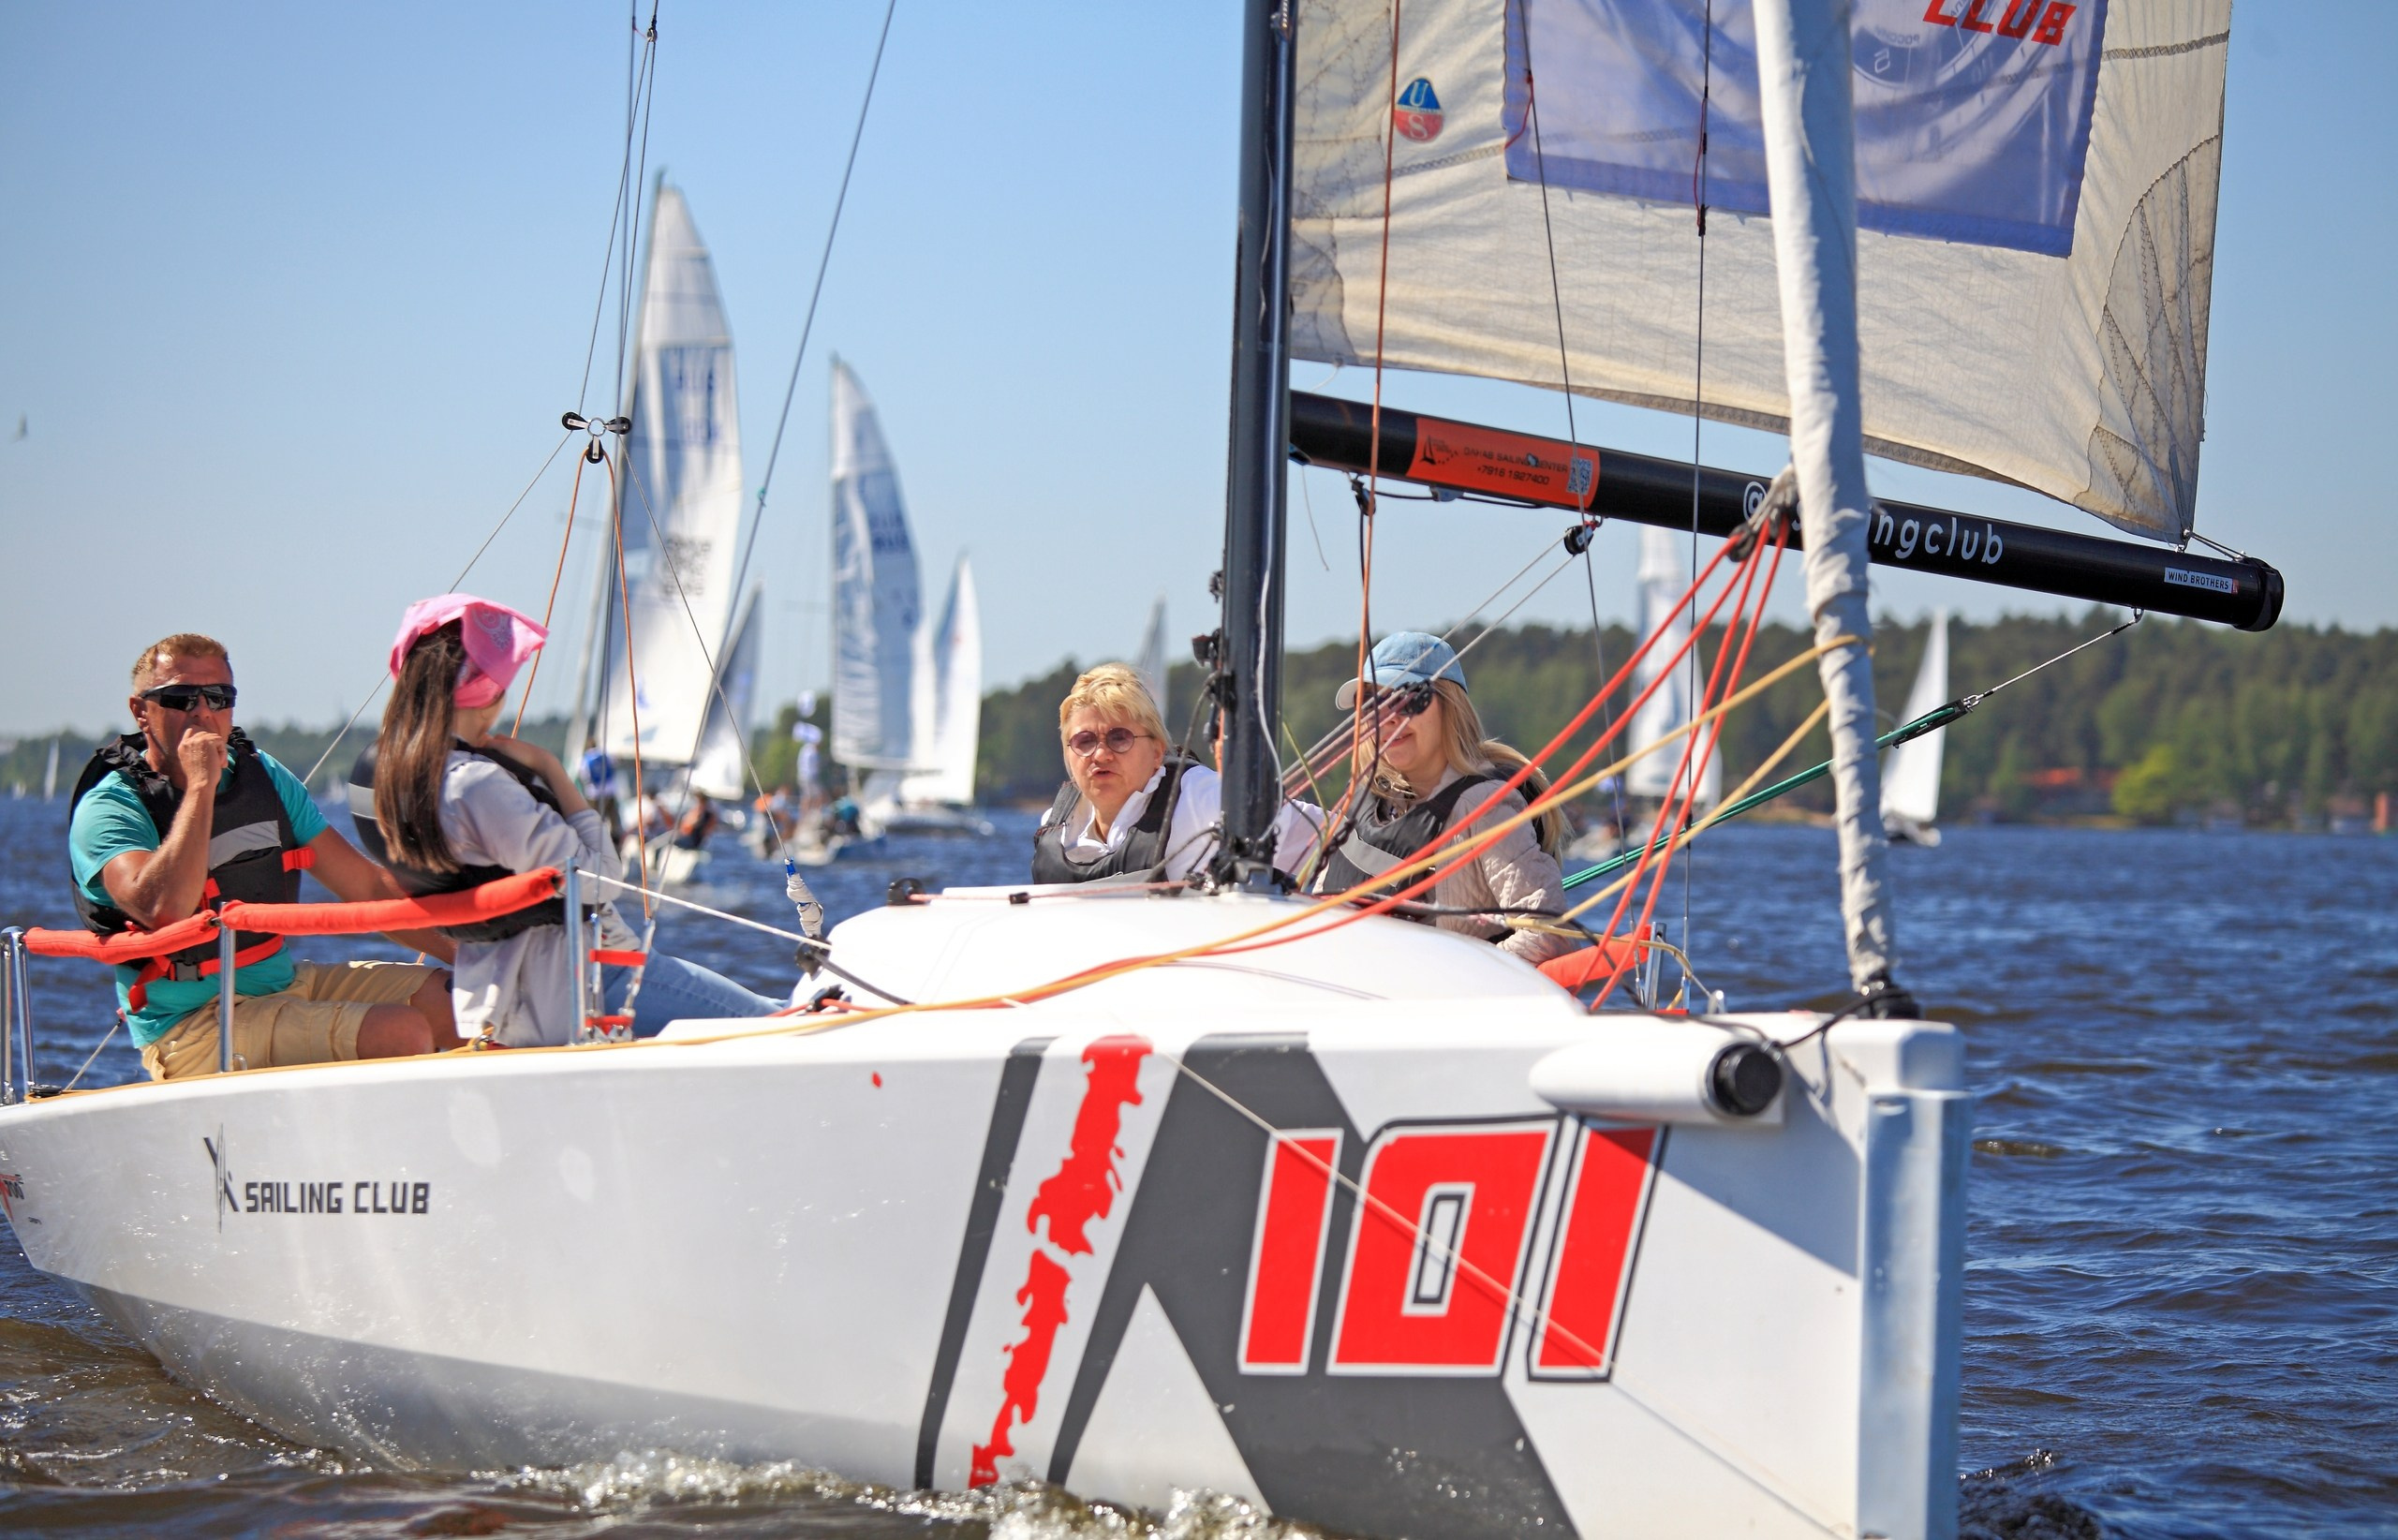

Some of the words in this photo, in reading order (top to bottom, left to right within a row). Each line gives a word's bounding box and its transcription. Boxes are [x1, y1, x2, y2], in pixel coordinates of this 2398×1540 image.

[2169, 570, 2188, 583] WIND
[2190, 574, 2229, 589] BROTHERS
[245, 1181, 344, 1214] SAILING
[353, 1181, 431, 1215] CLUB
[1237, 1113, 1669, 1384] 101
